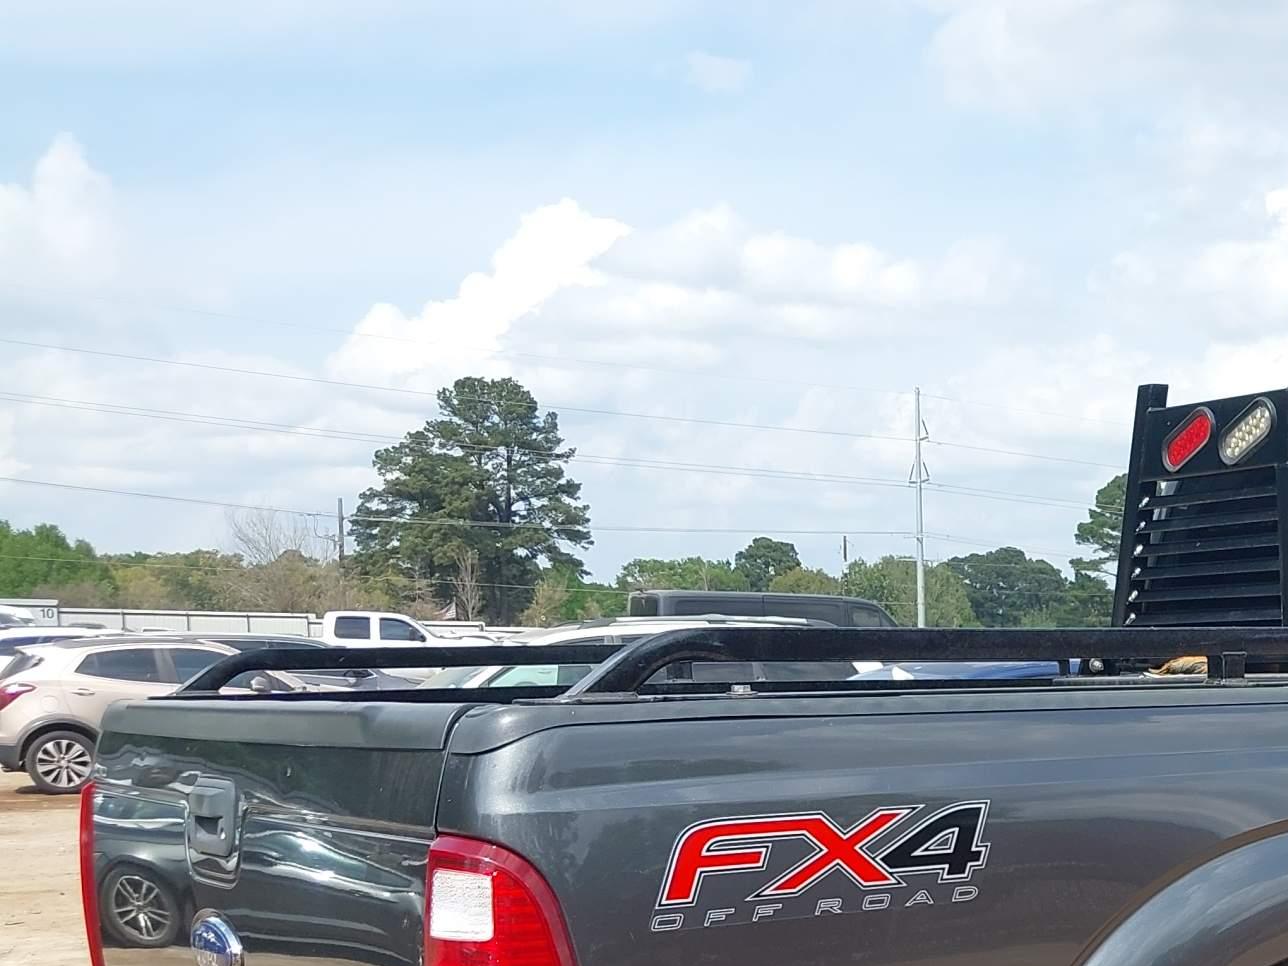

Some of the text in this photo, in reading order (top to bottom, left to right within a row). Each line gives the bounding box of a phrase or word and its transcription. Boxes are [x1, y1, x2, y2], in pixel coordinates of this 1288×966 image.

[40, 608, 55, 619] 10
[655, 800, 991, 909] FX4
[651, 886, 979, 932] OFF ROAD
